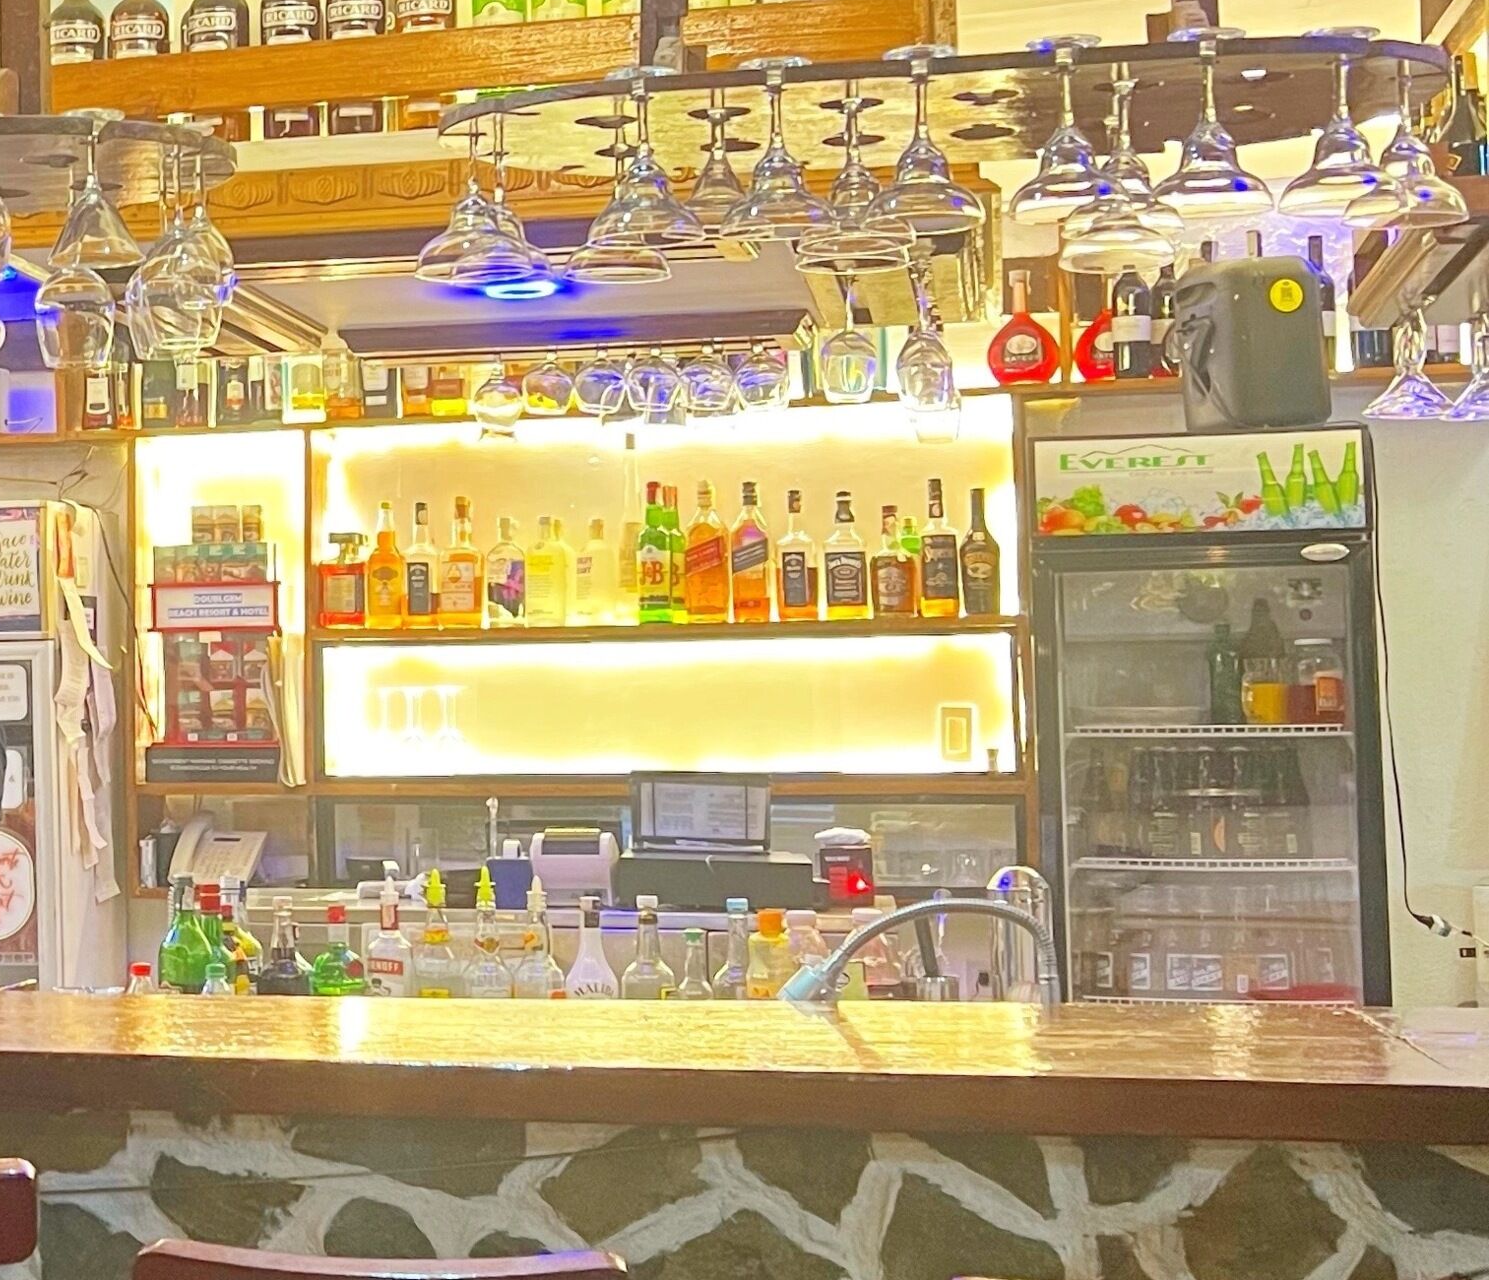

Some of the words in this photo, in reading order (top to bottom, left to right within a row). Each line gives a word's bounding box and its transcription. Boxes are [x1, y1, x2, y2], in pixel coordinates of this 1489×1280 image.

[265, 9, 314, 25] RICARD
[330, 4, 379, 18] RICARD
[114, 22, 162, 38] RICARD
[1060, 453, 1214, 471] EVEREST
